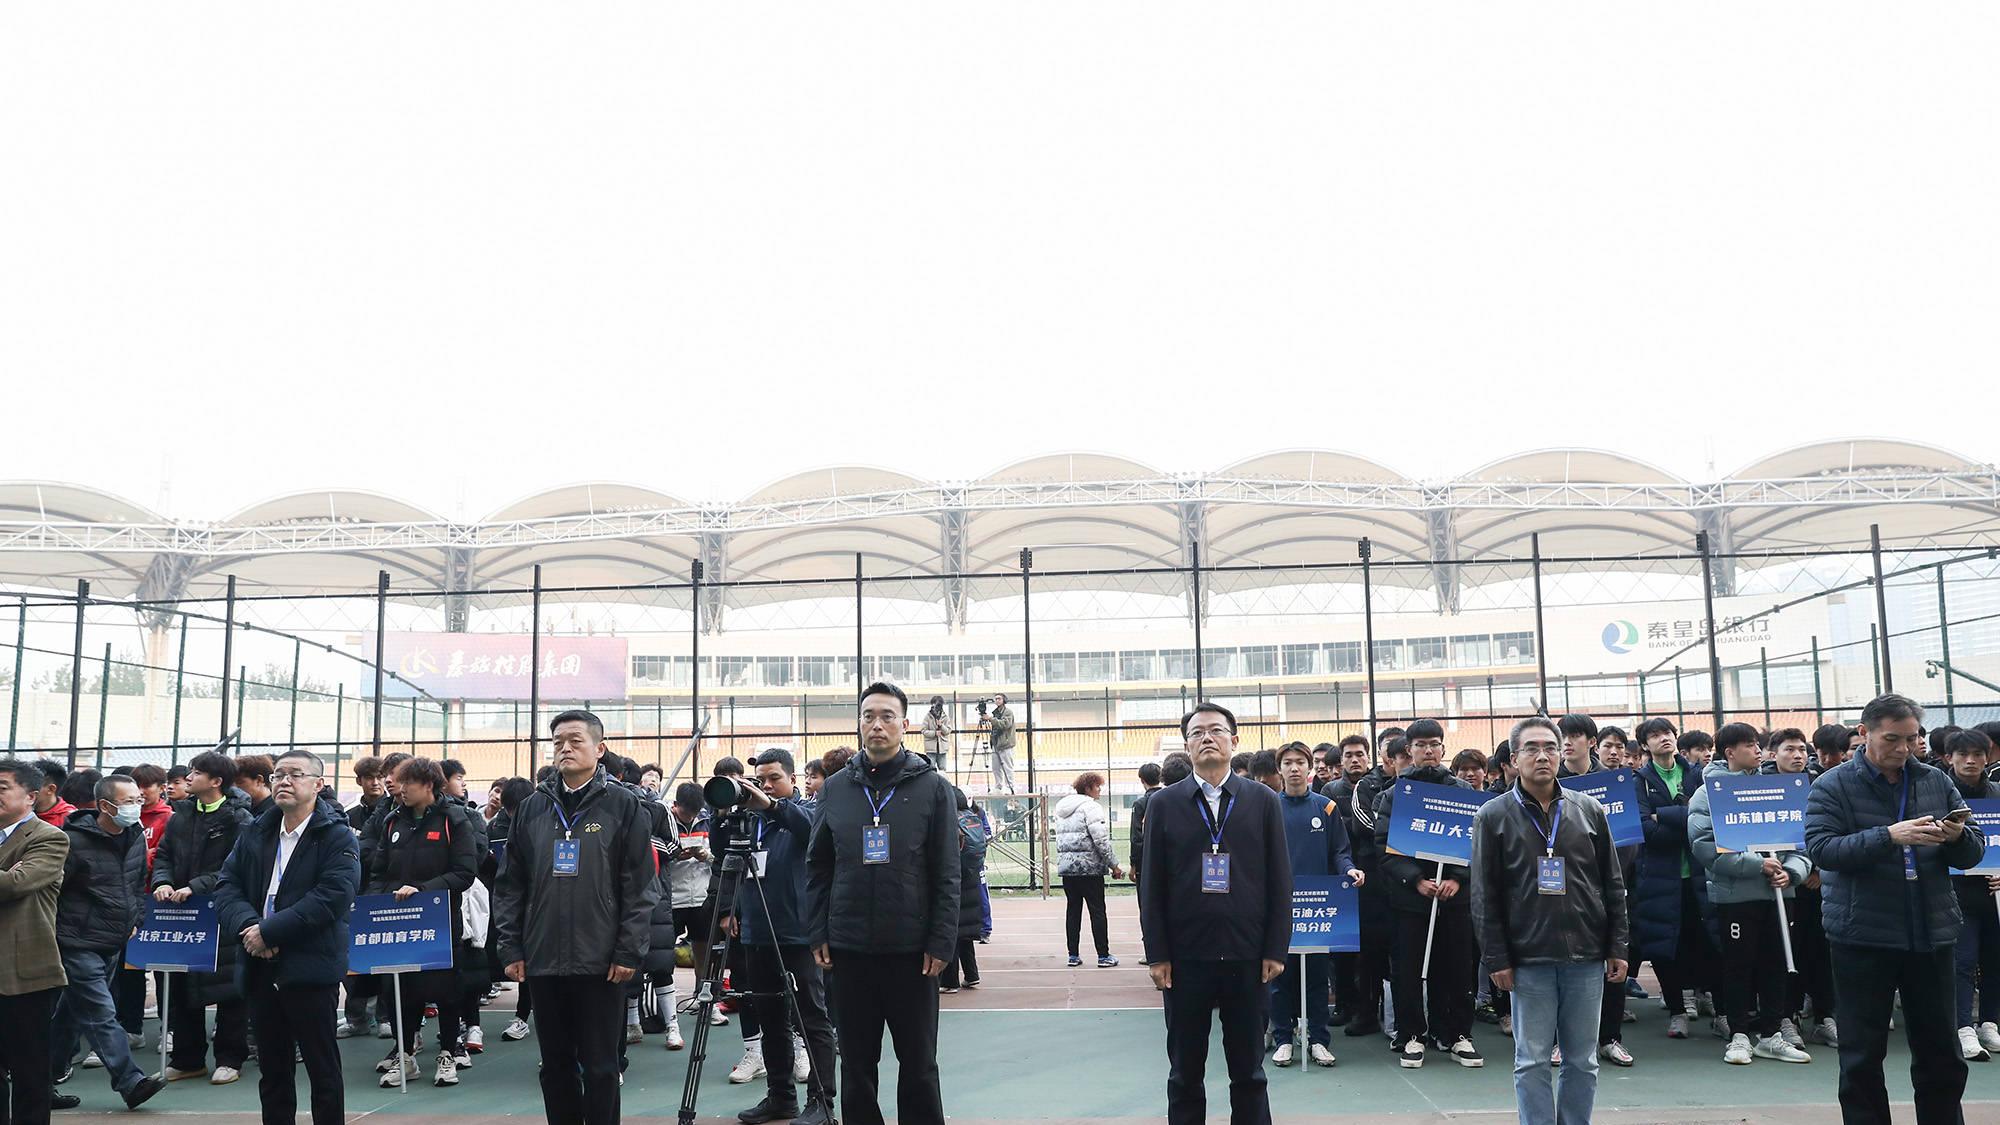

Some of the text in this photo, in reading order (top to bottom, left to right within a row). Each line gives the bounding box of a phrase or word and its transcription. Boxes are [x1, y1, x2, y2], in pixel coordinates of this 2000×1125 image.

[1648, 641, 1677, 649] BANK
[1693, 634, 1772, 646] UANGDAO
[1725, 810, 1803, 825] 山东体育学院
[1292, 907, 1338, 918] 石油大学
[1292, 922, 1333, 933] 岛分校
[1730, 922, 1741, 939] 8
[138, 930, 207, 944] 北京工业大学
[354, 929, 436, 946] 首都体育学院
